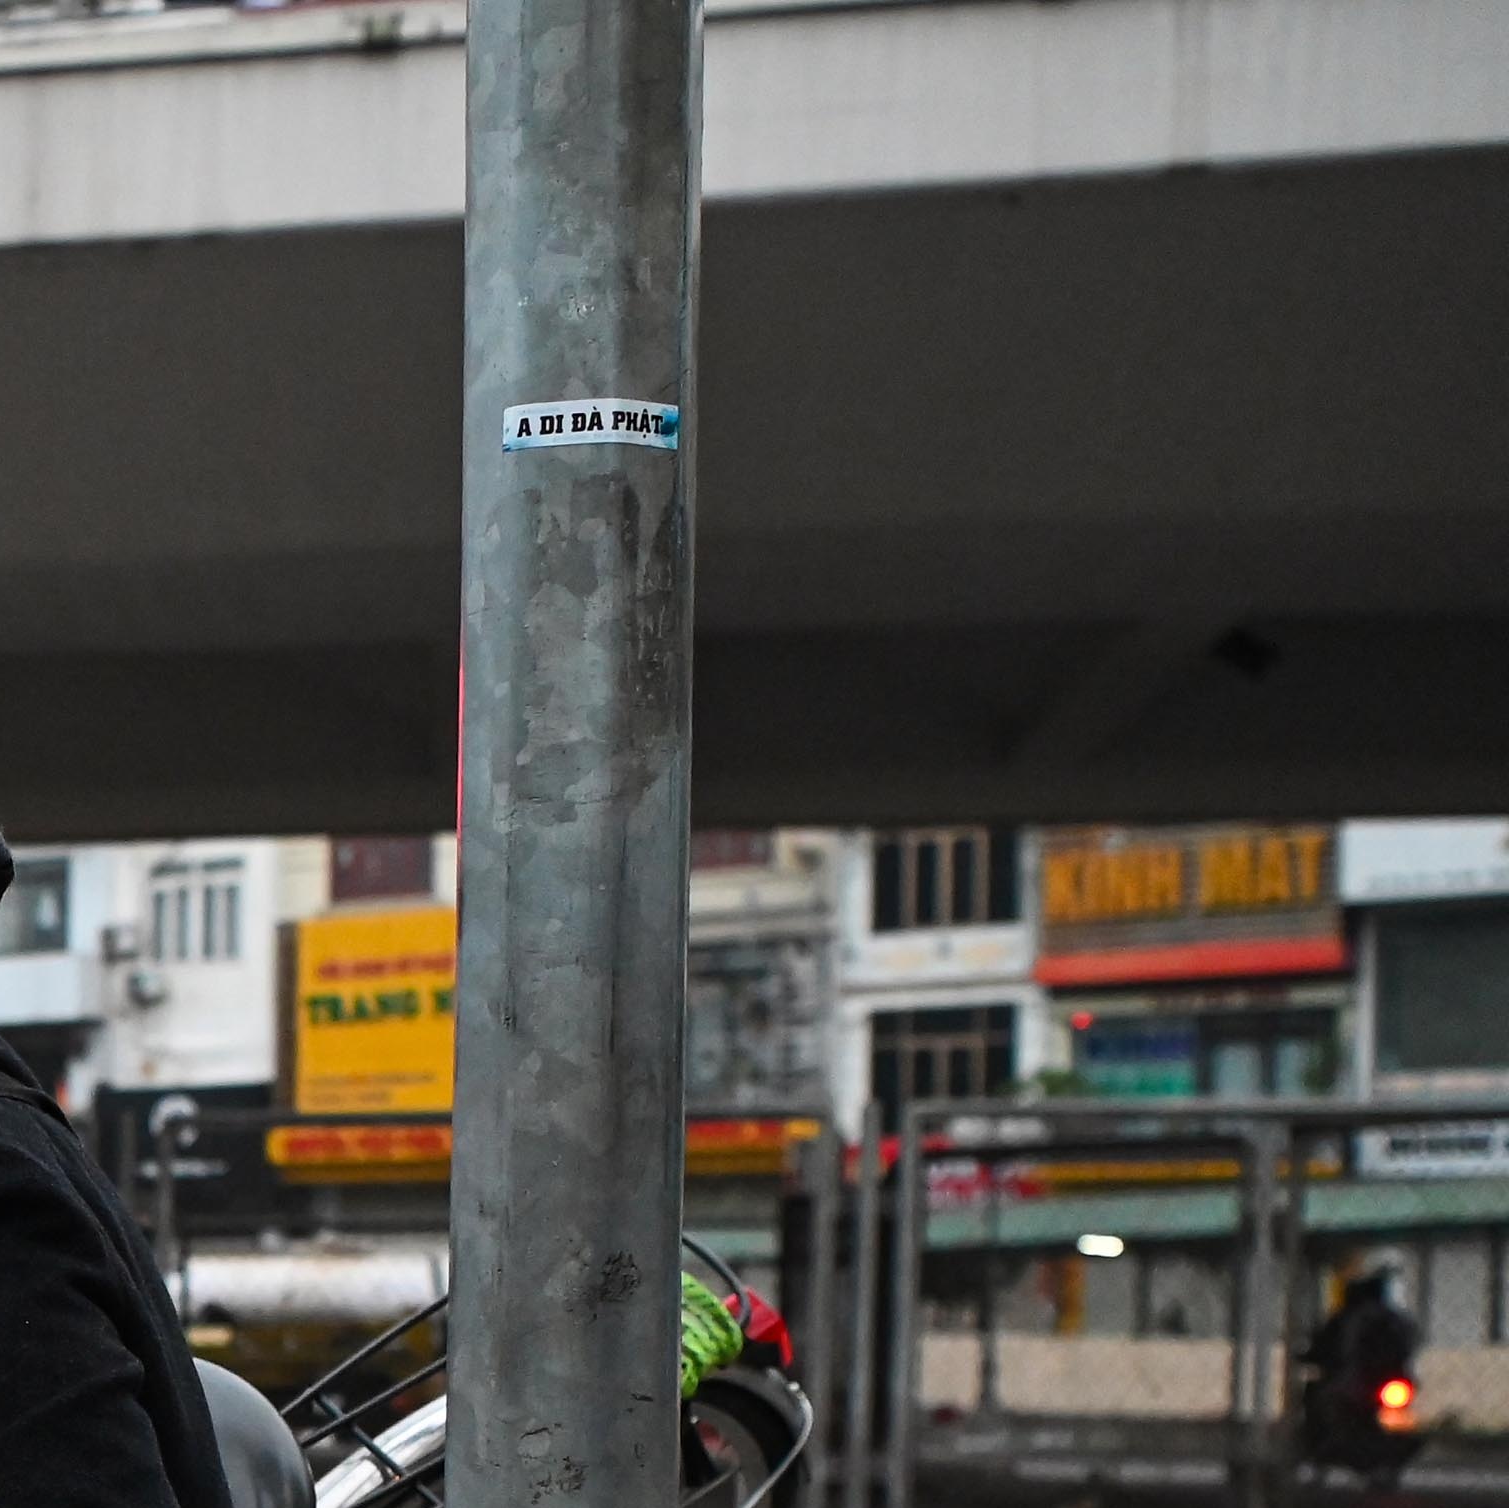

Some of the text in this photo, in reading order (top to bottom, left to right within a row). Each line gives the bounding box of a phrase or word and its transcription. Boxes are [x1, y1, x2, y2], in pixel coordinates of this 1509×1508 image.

[517, 406, 664, 438] A DI ĐÀ PHẬT
